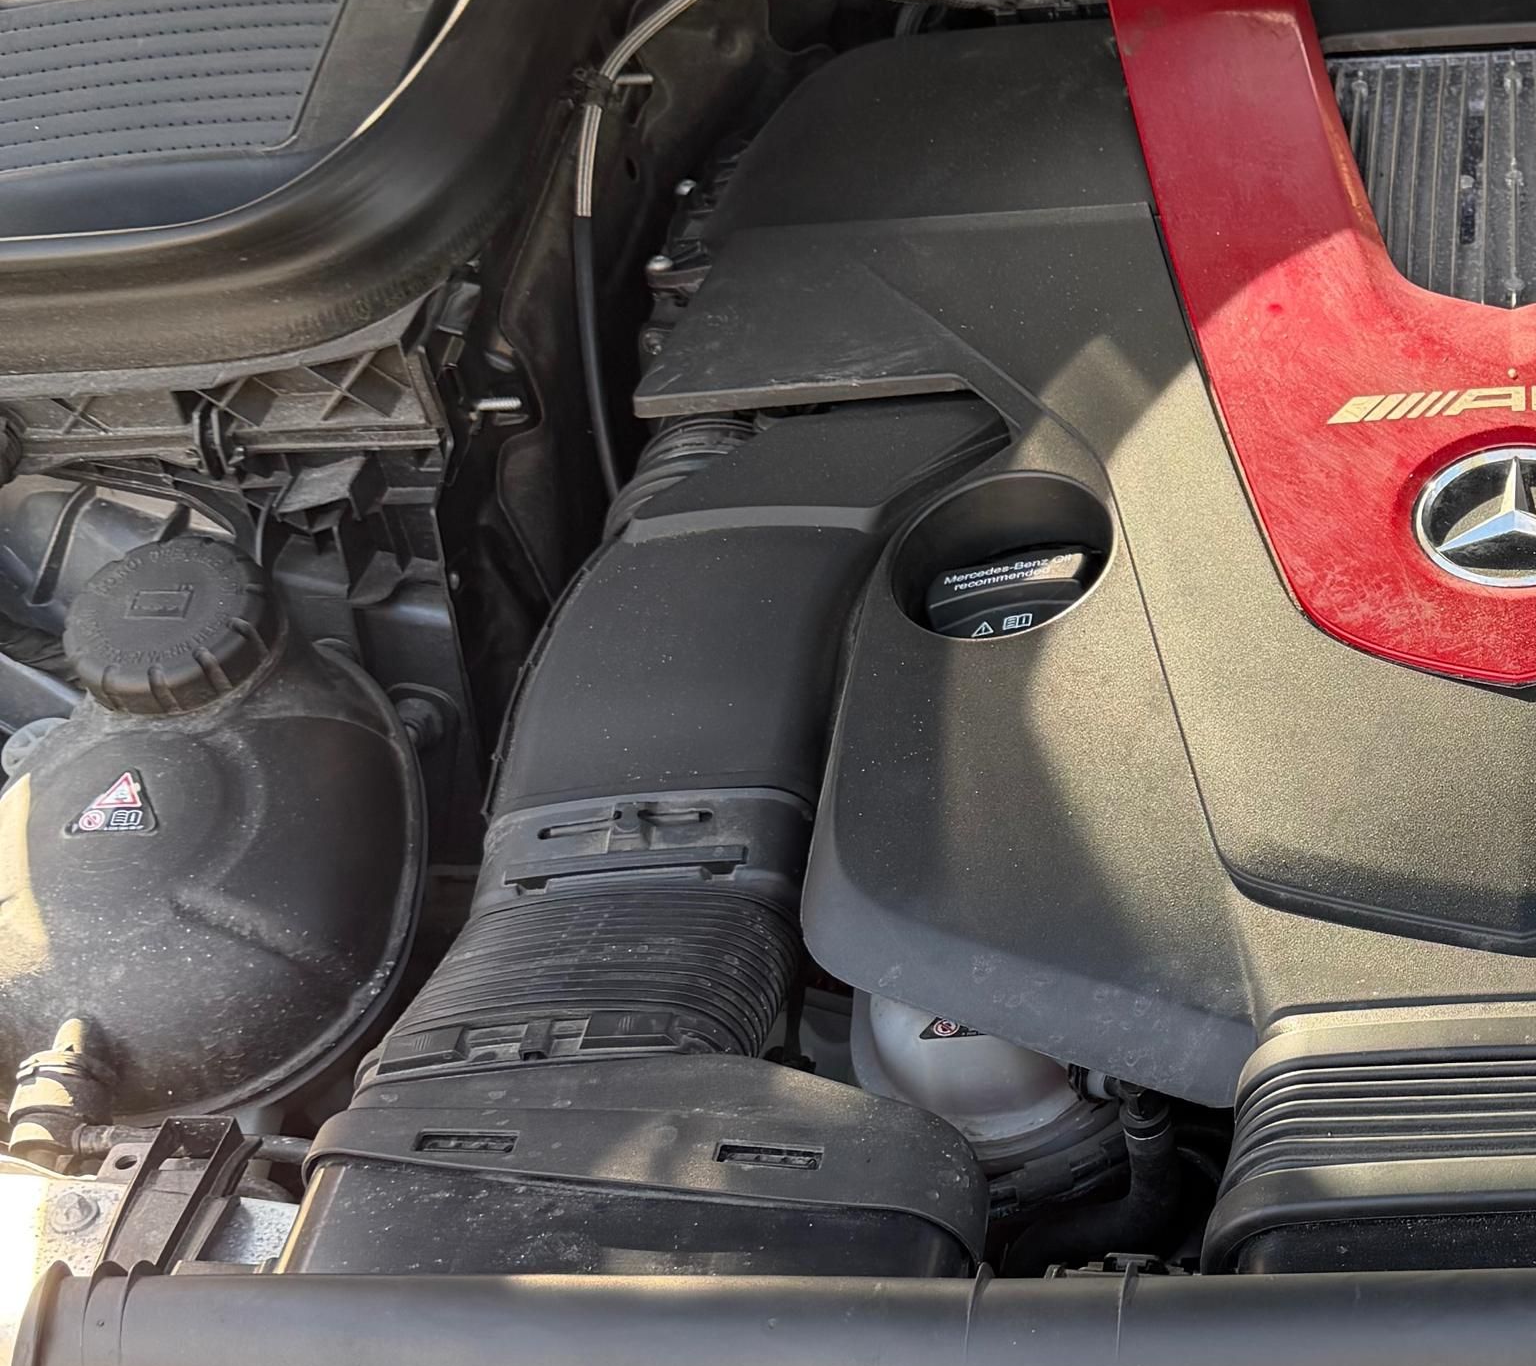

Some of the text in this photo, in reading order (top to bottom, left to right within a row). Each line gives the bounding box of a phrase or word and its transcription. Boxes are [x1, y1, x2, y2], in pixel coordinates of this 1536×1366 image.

[944, 553, 1073, 585] Mercedes-Benz Oil
[954, 566, 1050, 591] recommended
